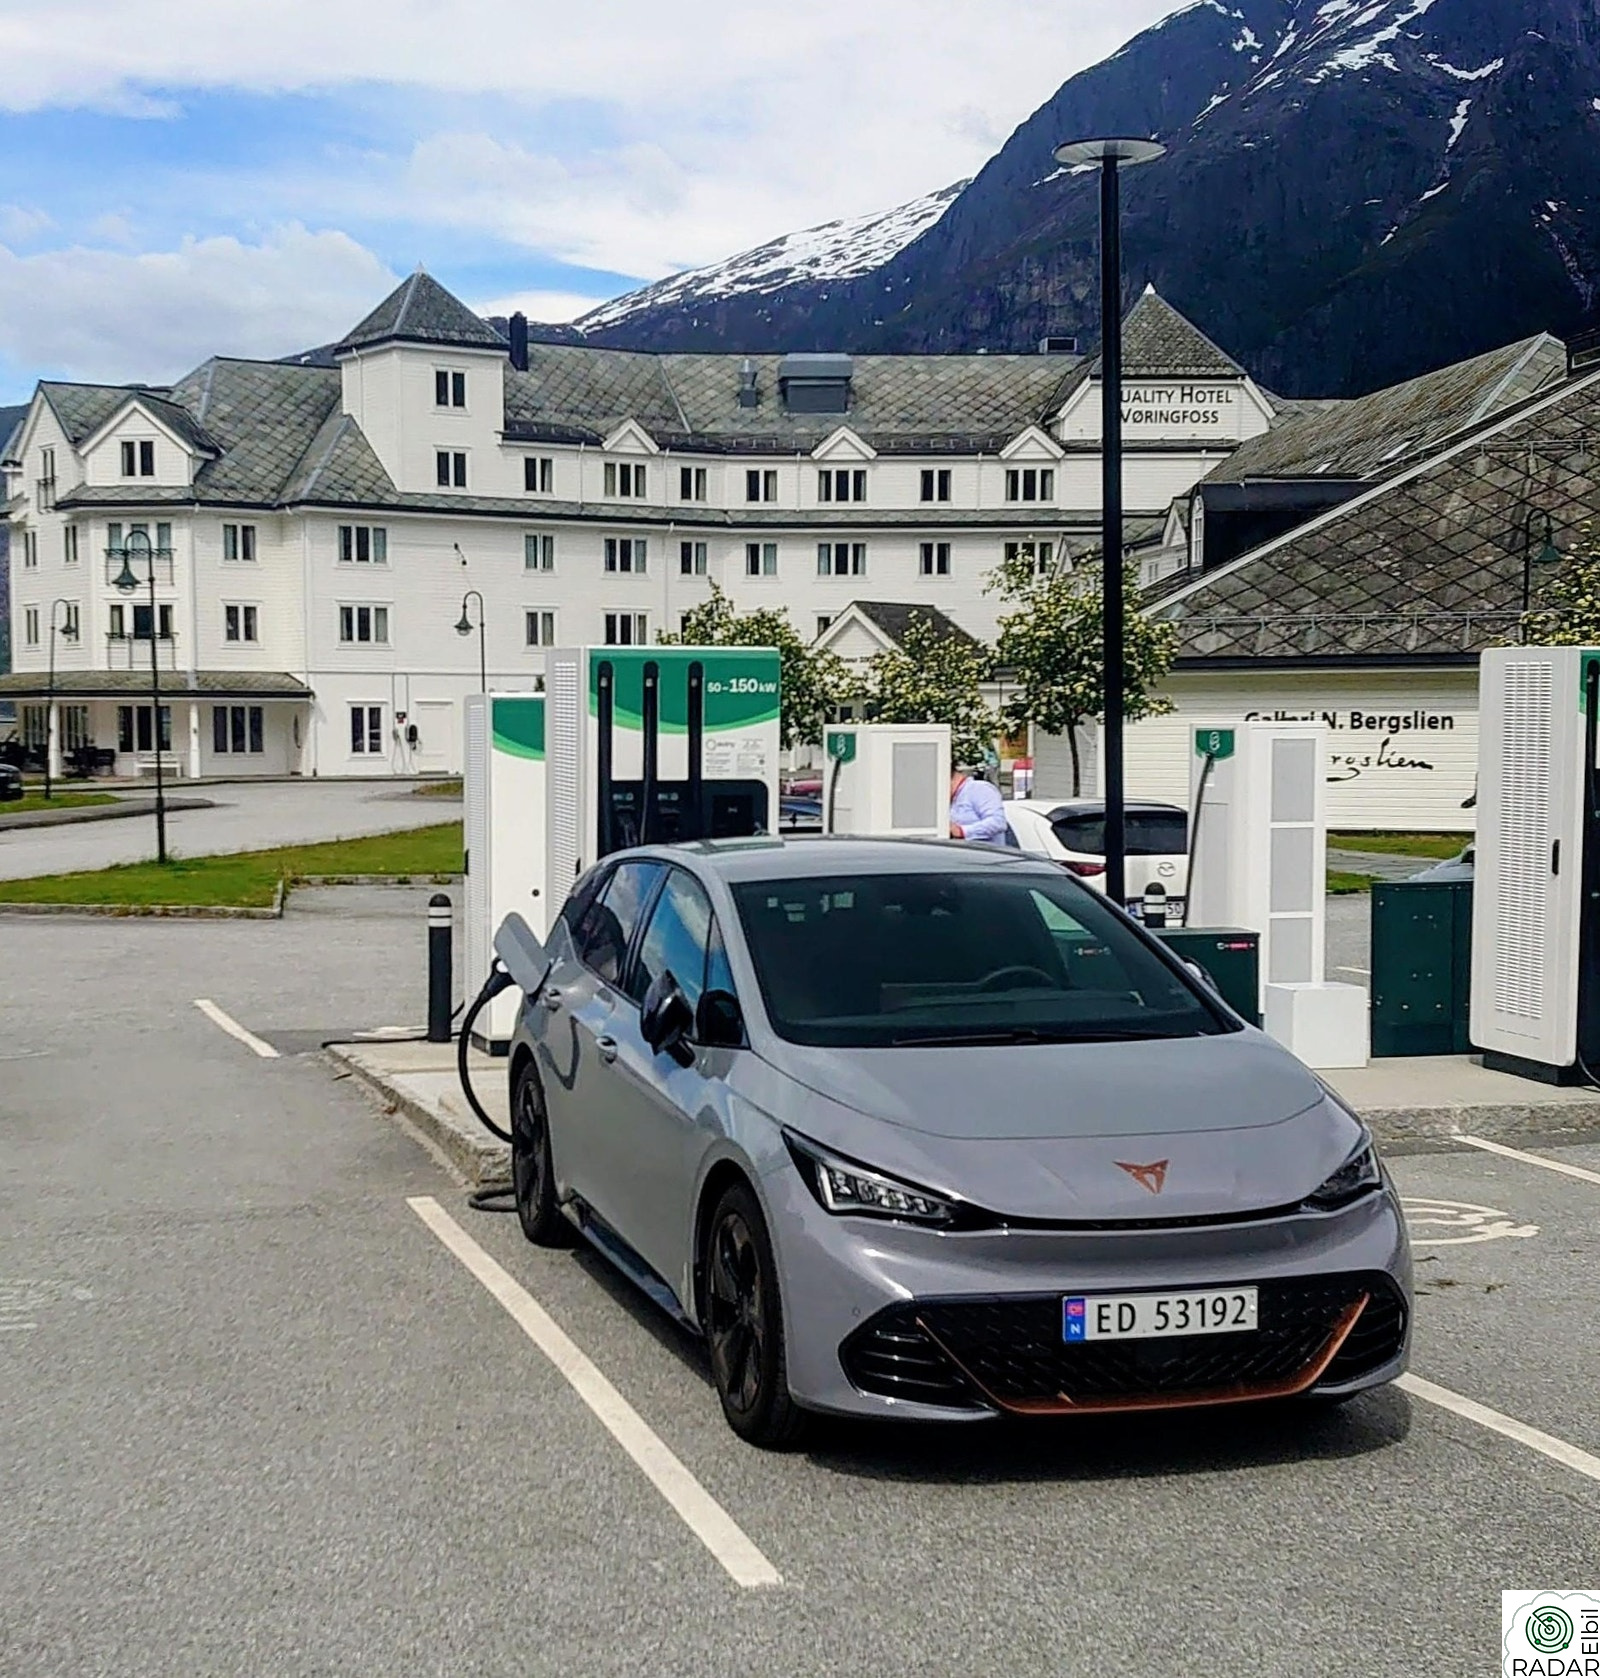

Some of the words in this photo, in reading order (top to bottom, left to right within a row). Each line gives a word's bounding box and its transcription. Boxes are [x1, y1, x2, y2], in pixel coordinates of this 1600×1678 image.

[1120, 389, 1175, 403] UALITY
[1181, 386, 1233, 403] HOTEL
[1121, 408, 1219, 423] VØRINGFOSS
[1350, 710, 1454, 733] Bergslien
[1070, 1323, 1081, 1334] N
[1097, 1302, 1136, 1334] ED
[1154, 1295, 1247, 1331] 53192
